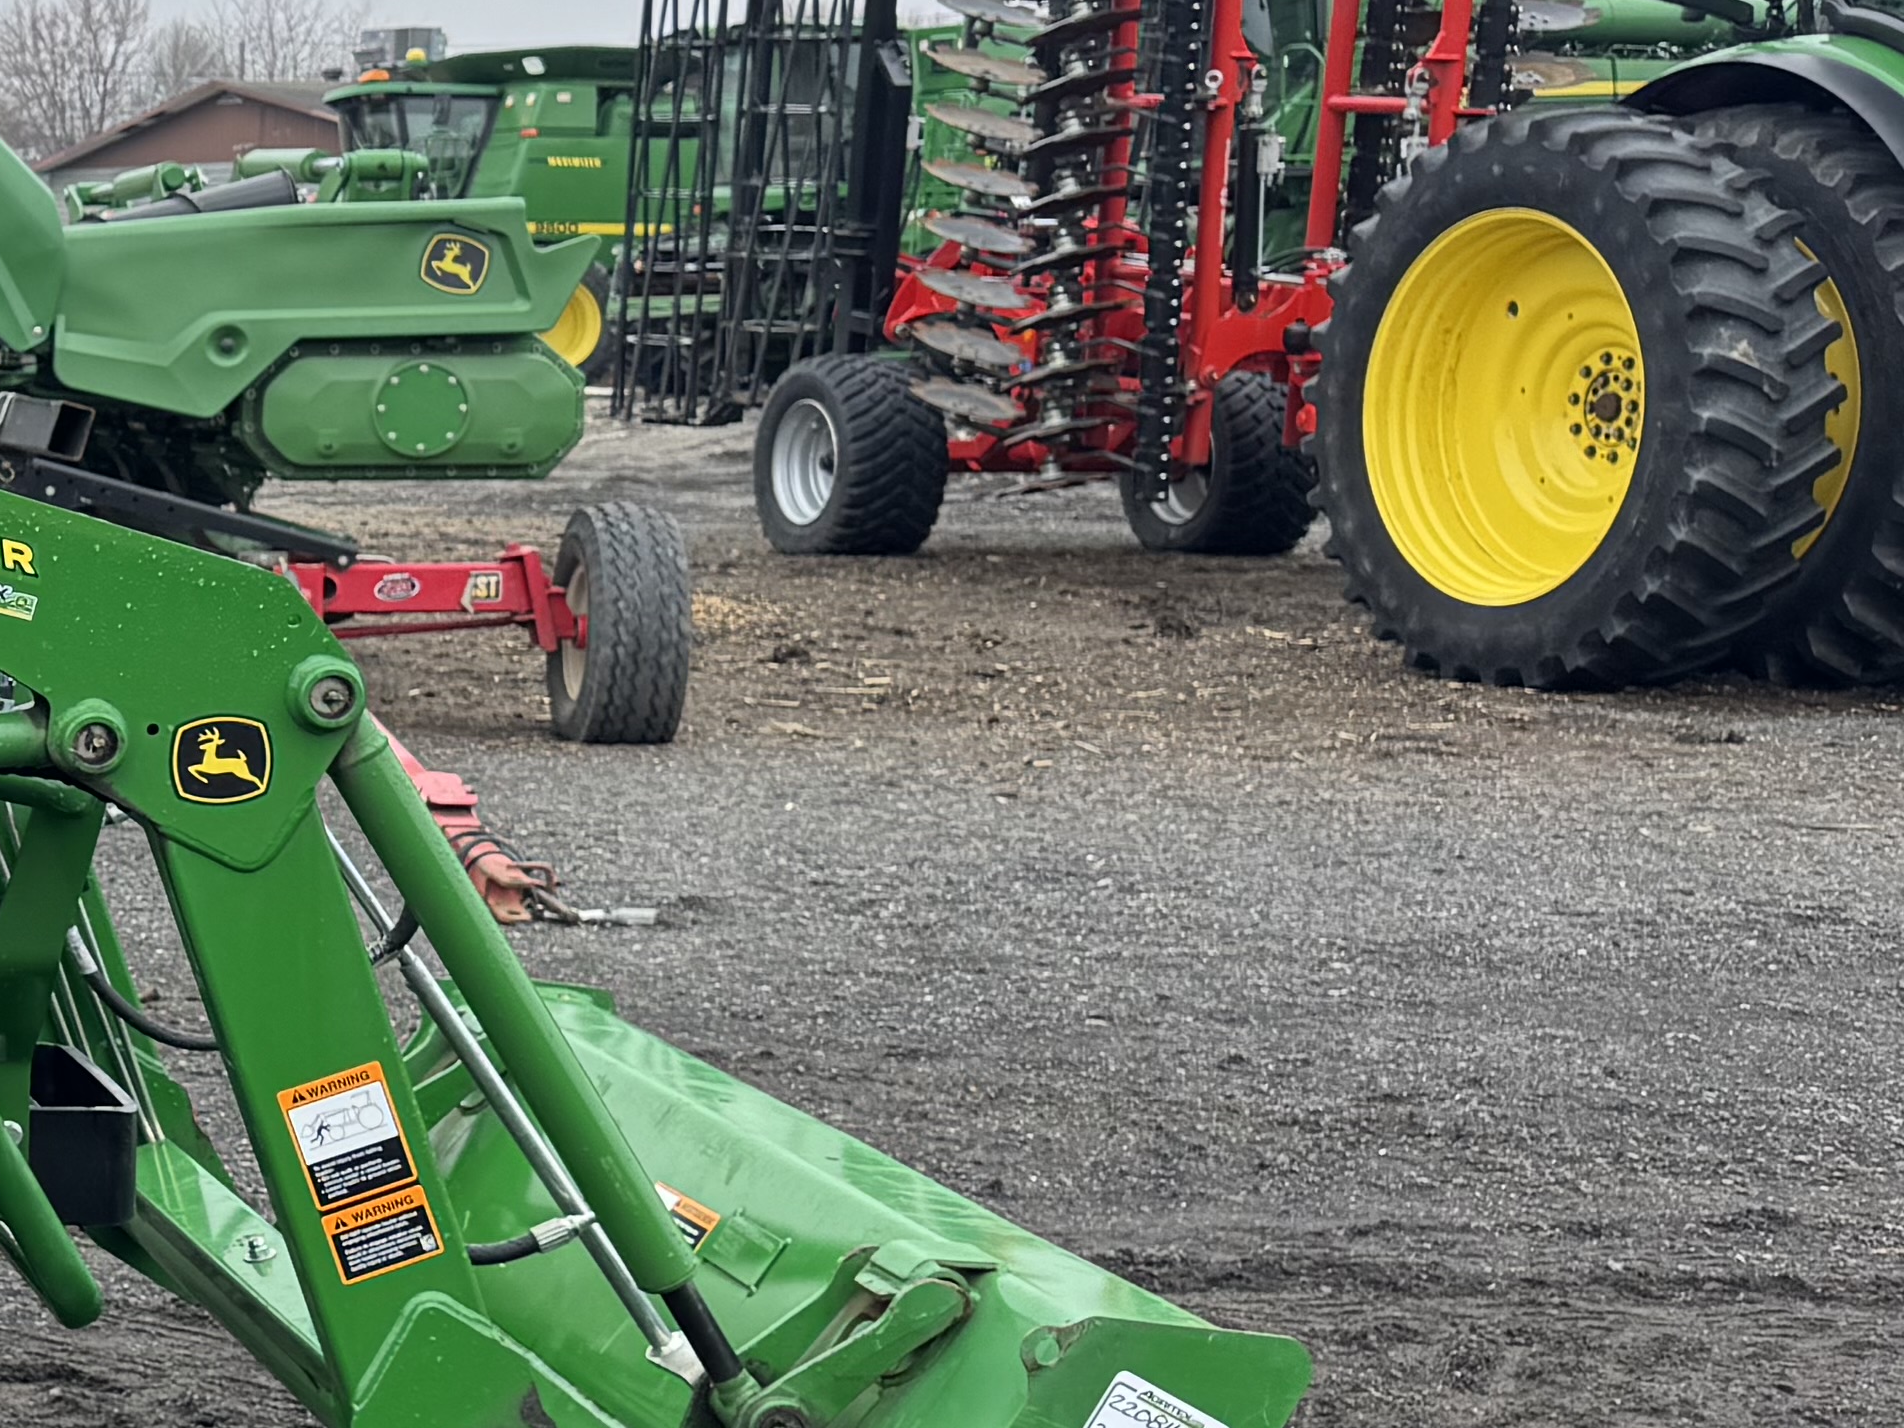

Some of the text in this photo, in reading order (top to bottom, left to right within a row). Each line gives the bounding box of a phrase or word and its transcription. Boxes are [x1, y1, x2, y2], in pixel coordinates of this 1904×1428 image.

[1, 538, 37, 576] R
[305, 1070, 371, 1100] WARNING
[351, 1194, 415, 1223] WARNING
